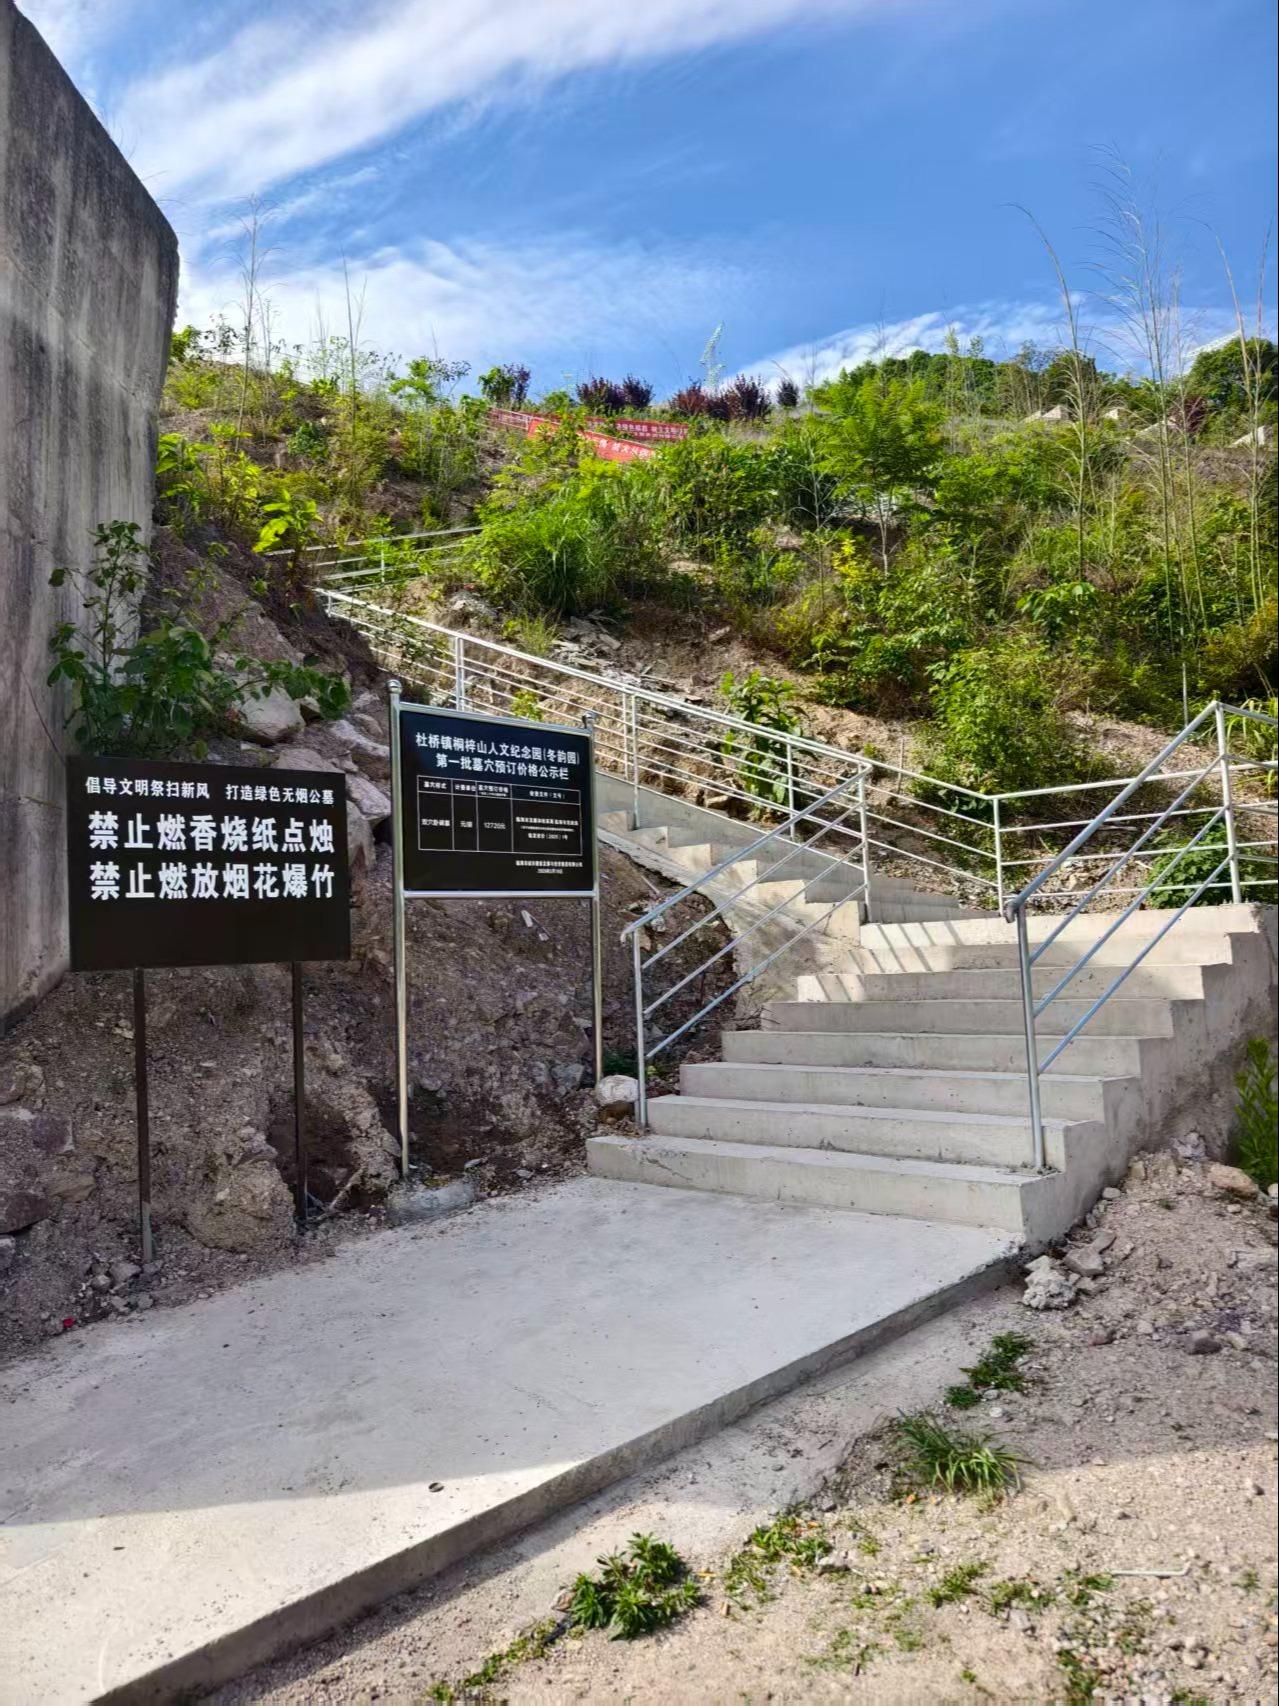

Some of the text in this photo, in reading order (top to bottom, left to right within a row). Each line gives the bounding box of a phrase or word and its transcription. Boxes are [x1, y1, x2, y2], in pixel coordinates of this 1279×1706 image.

[435, 753, 569, 780] 第一批墓穴预订价格公示栏
[85, 776, 335, 805] 倡导文明祭扫新风 打造绿色无烟公墓
[87, 810, 335, 854] 禁止燃香烧纸点烛
[89, 860, 335, 901] 禁止燃放烟花爆竹
